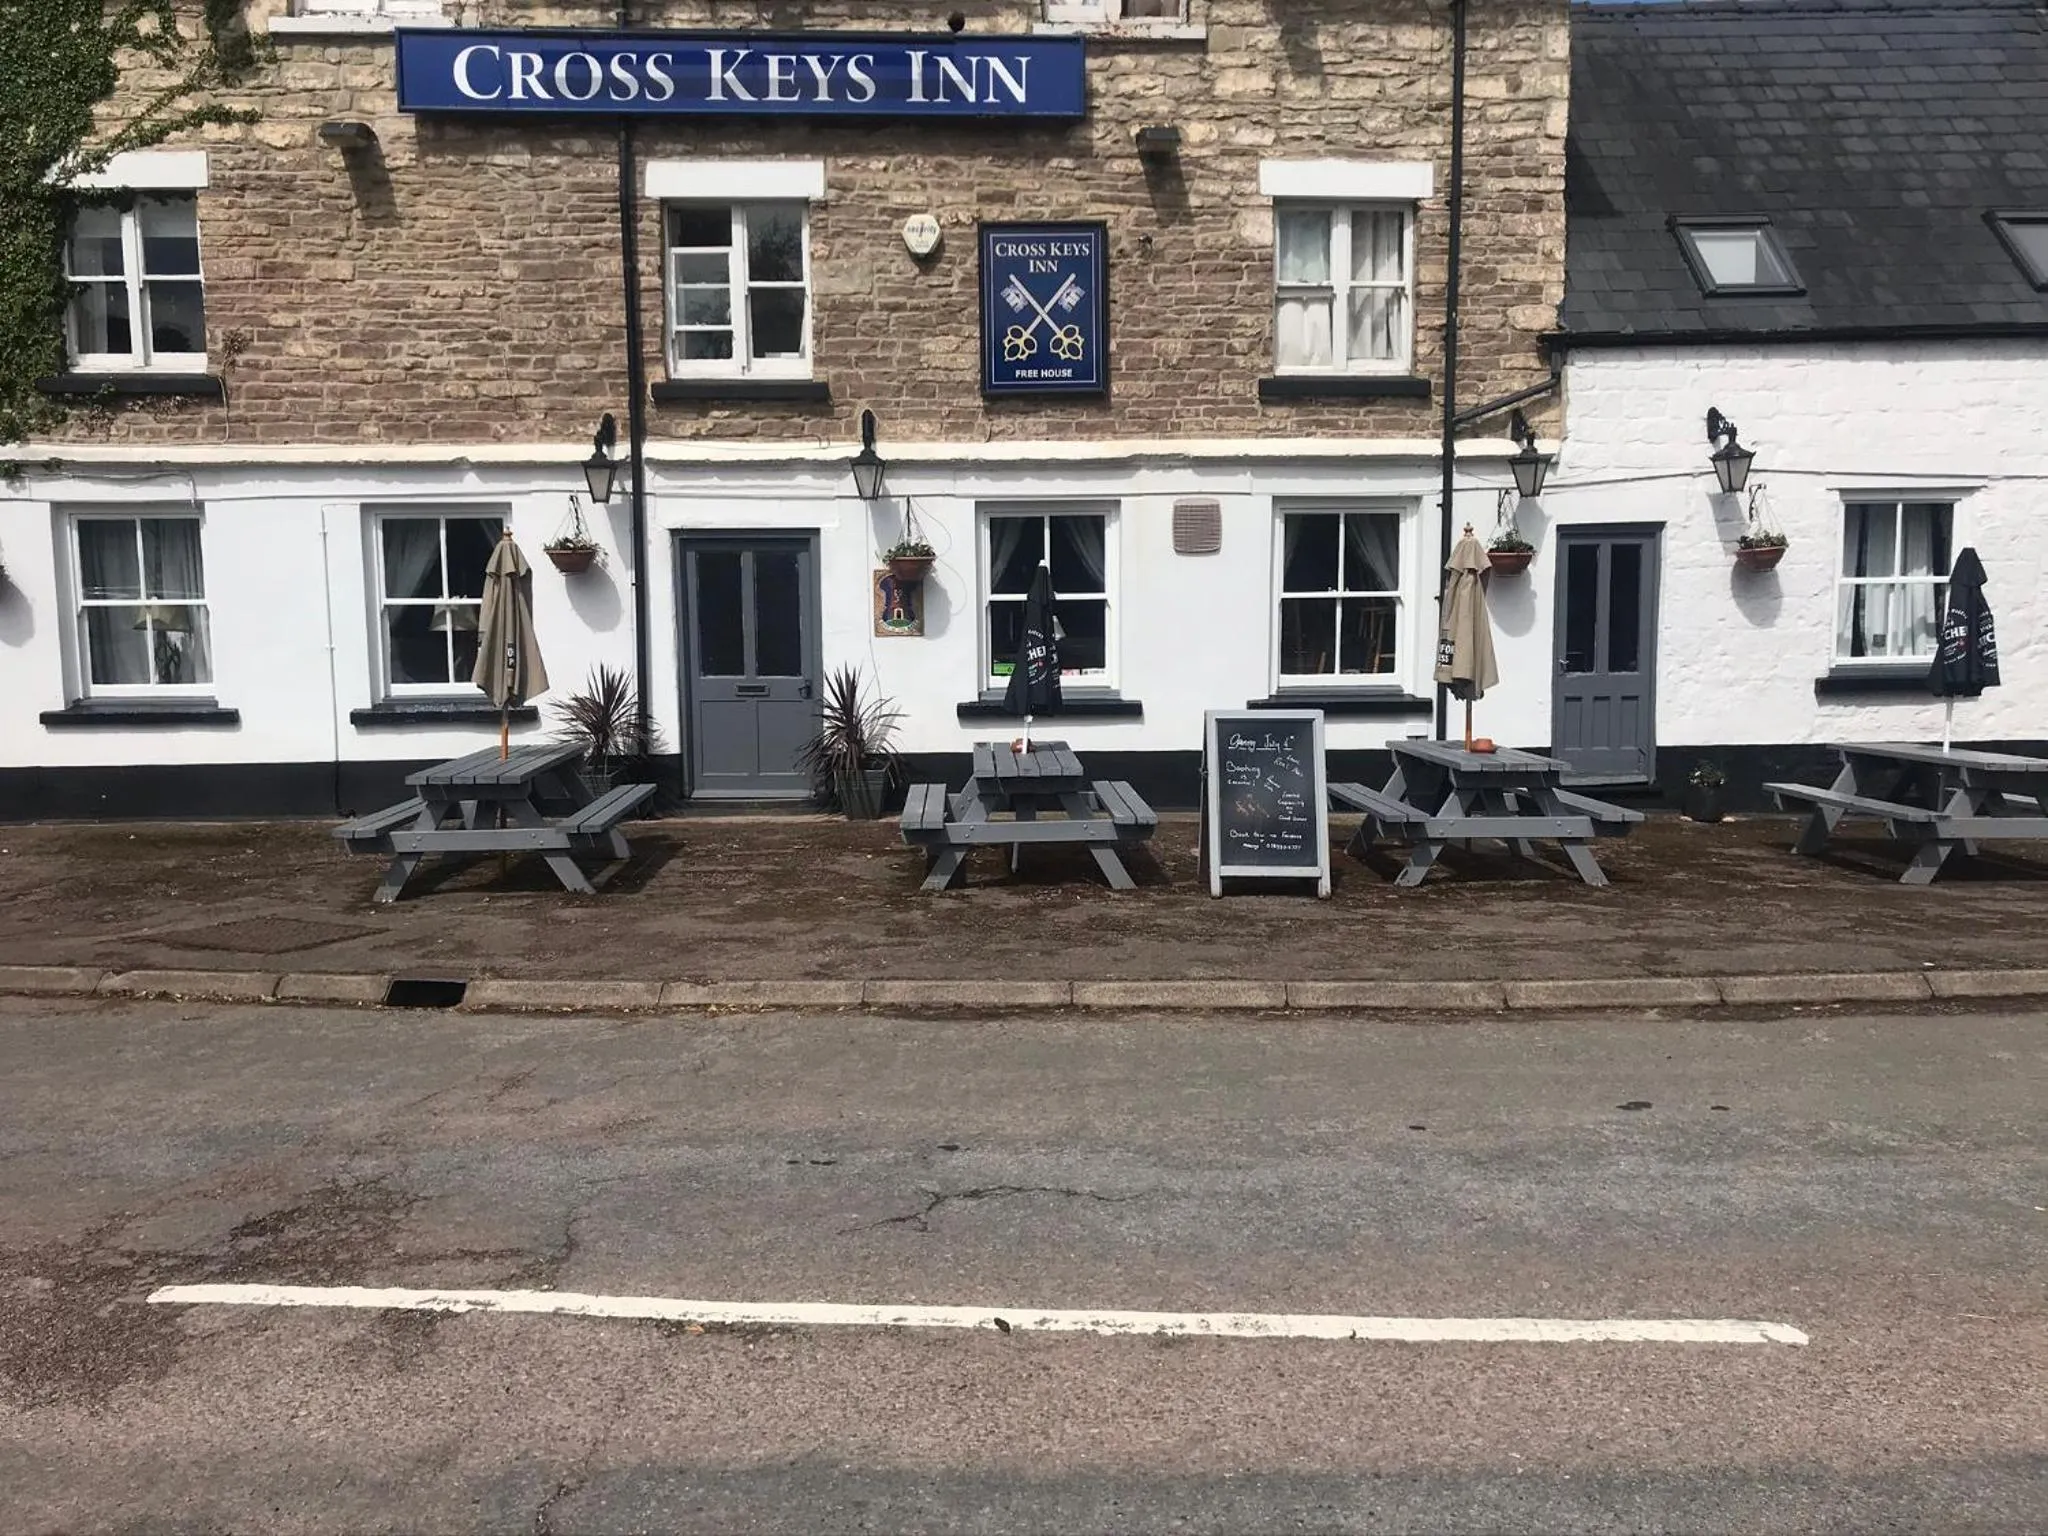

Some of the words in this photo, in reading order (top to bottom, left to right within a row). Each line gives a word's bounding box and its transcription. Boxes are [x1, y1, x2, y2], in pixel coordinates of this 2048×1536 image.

[452, 43, 676, 102] CROSS
[703, 47, 877, 103] KEYS
[904, 49, 1032, 104] INN
[995, 242, 1046, 257] CROSS
[1050, 242, 1090, 257] KEYS
[1028, 259, 1059, 273] INN
[1015, 369, 1039, 378] FREE
[1041, 368, 1073, 378] HOUSE
